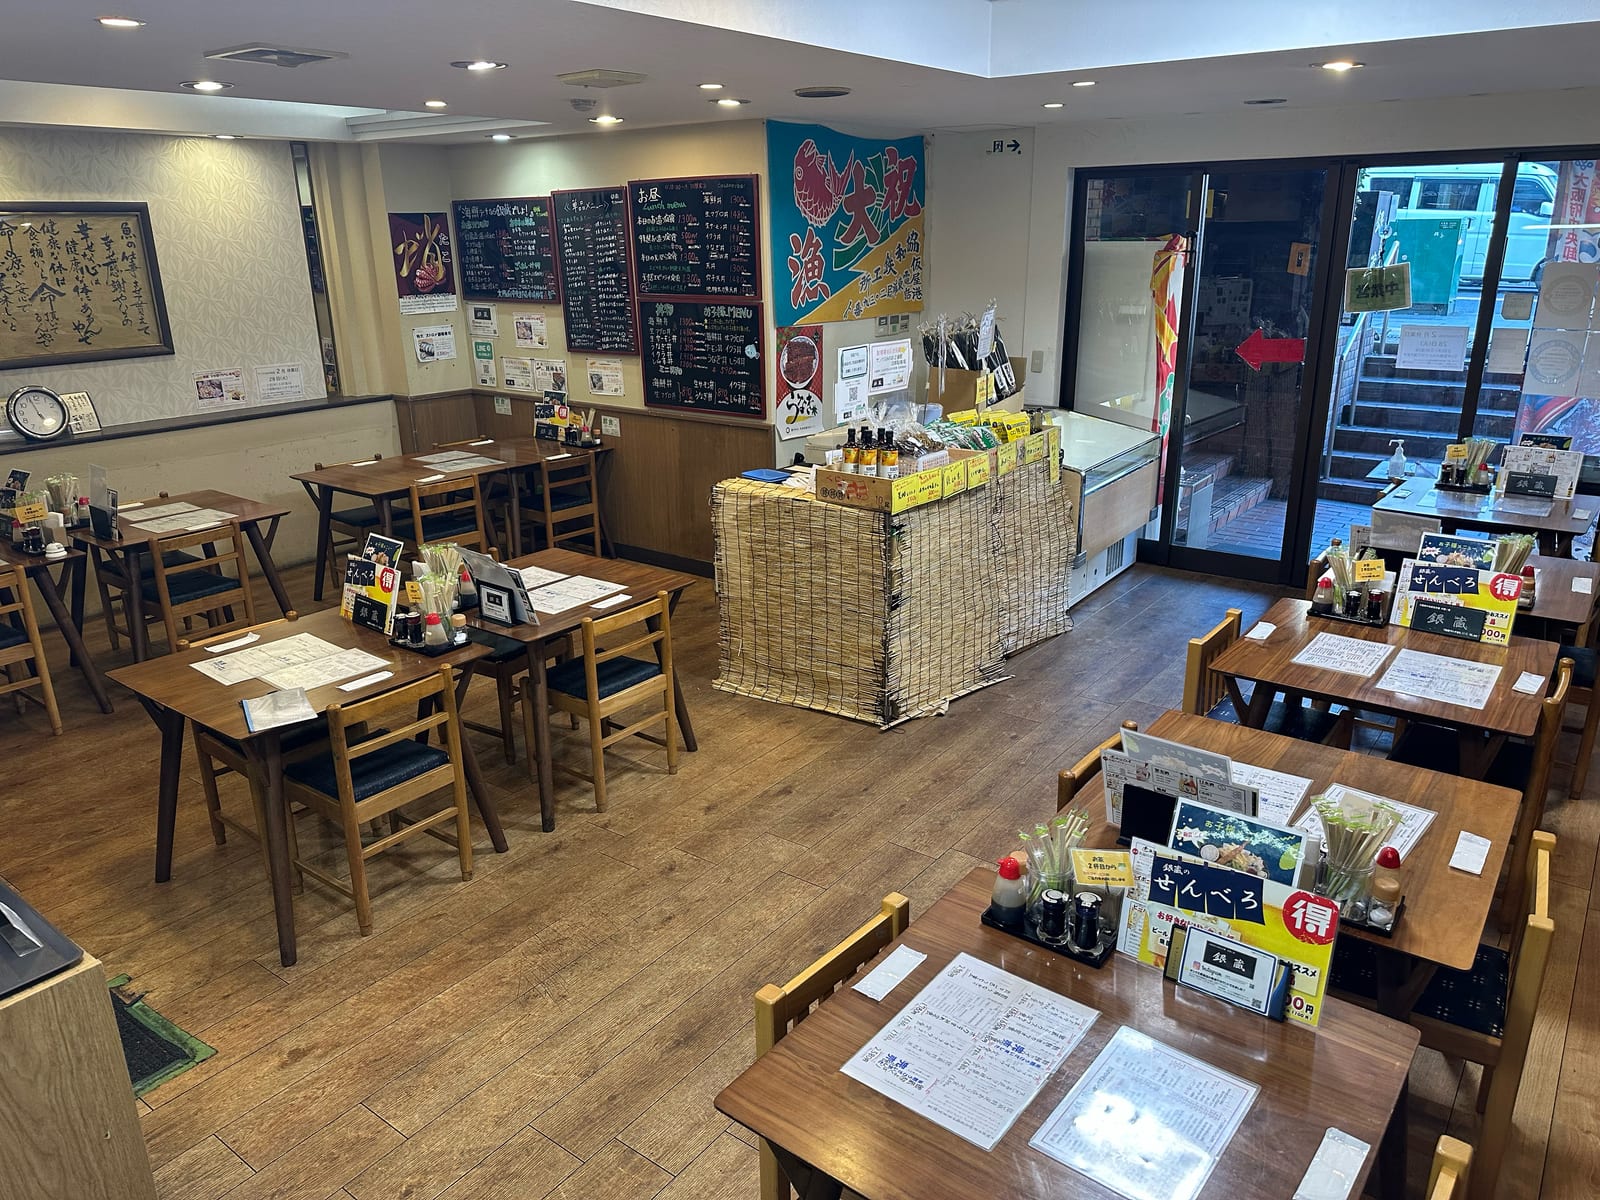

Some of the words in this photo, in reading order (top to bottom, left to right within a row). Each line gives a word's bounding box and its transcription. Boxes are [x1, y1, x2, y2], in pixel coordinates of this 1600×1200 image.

[881, 147, 921, 221] 祝
[638, 187, 661, 203] お昼
[842, 160, 880, 245] 大
[788, 227, 831, 310] 漁
[347, 568, 375, 580] せんべろ
[1412, 575, 1476, 588] せんべろ
[1494, 577, 1518, 597] 得
[1426, 612, 1468, 631] 銀蔵
[1153, 873, 1258, 909] せんべろ
[1291, 899, 1332, 937] 得
[1212, 951, 1246, 972] 銀蔵
